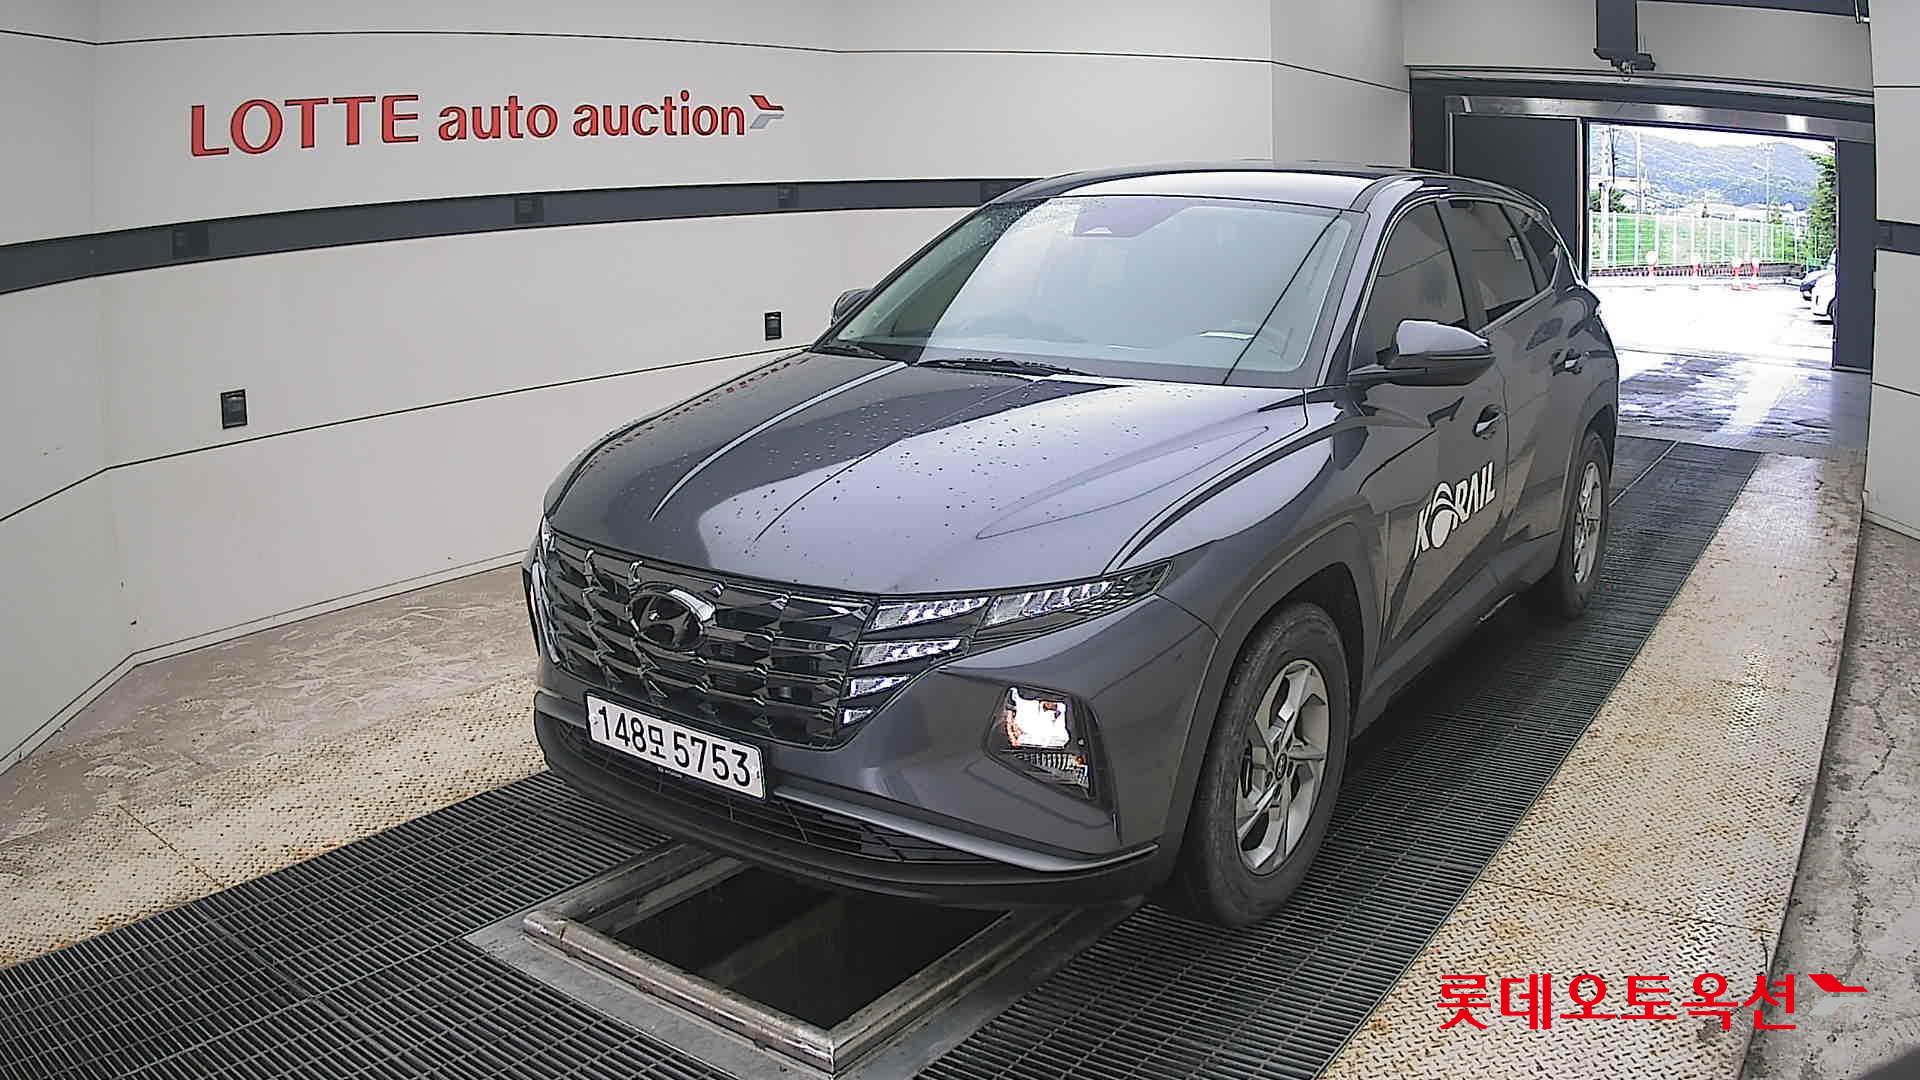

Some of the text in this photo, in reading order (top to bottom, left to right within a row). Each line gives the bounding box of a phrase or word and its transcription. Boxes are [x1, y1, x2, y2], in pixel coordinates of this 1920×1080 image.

[191, 91, 746, 157] LOTTE auto auction
[1413, 460, 1497, 560] KORAIL
[673, 730, 751, 787] 5753
